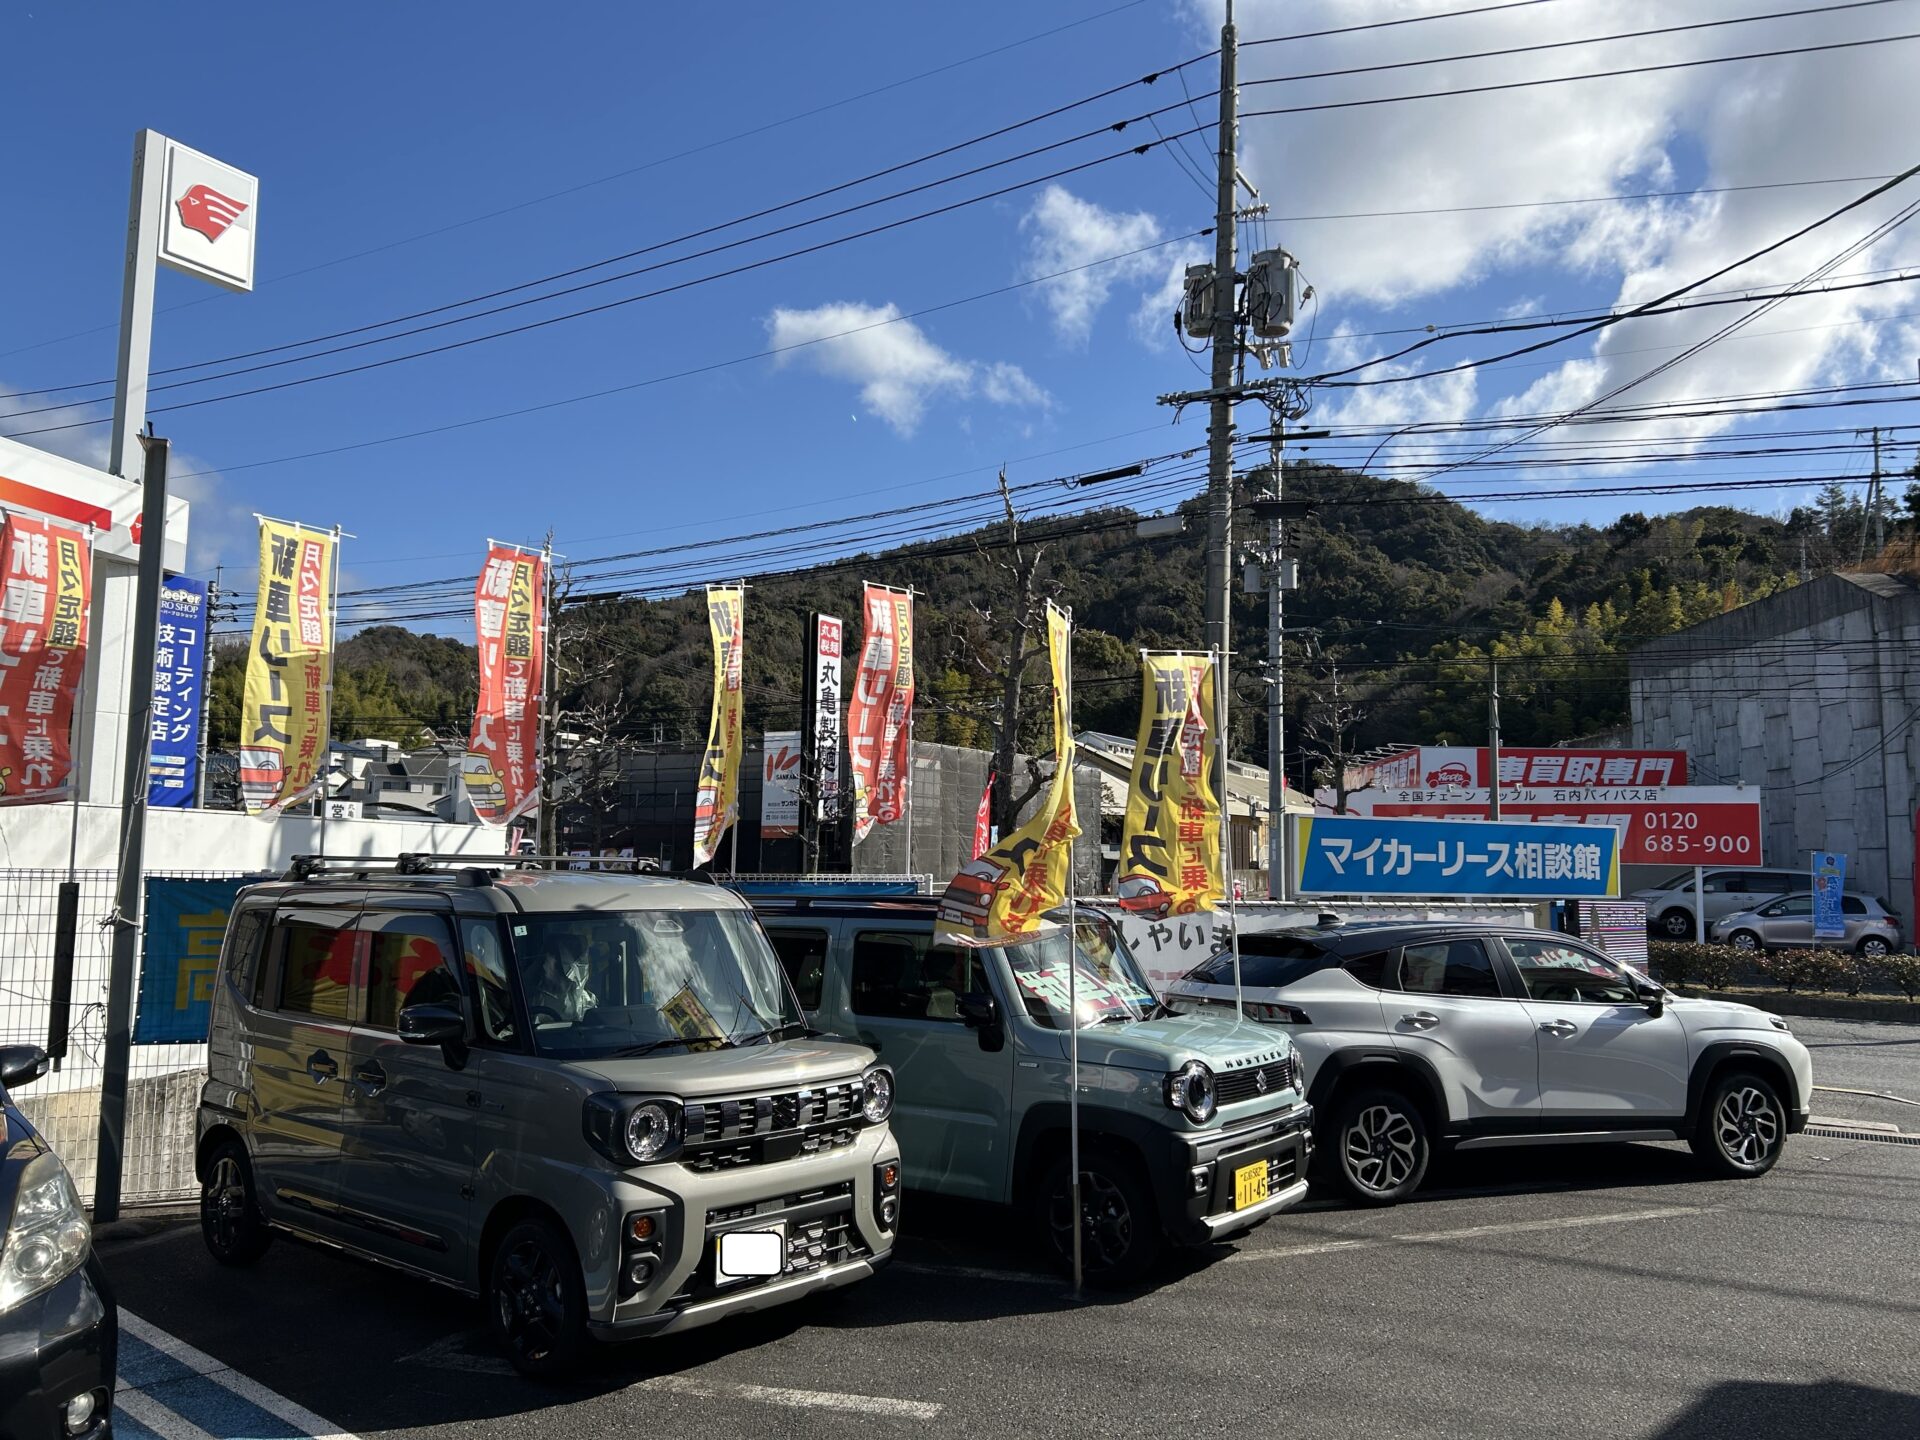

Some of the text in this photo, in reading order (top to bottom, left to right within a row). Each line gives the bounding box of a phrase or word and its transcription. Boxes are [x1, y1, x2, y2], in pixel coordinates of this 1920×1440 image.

[175, 603, 199, 613] SHOP
[151, 622, 176, 742] 技術認定店
[171, 626, 196, 743] コーティング
[1498, 756, 1674, 785] 車買取専門
[1398, 791, 1476, 802] 全国チェーン
[1644, 812, 1697, 829] 0120
[1645, 835, 1750, 853] 685-900
[1319, 836, 1601, 881] マイカーリース相談館
